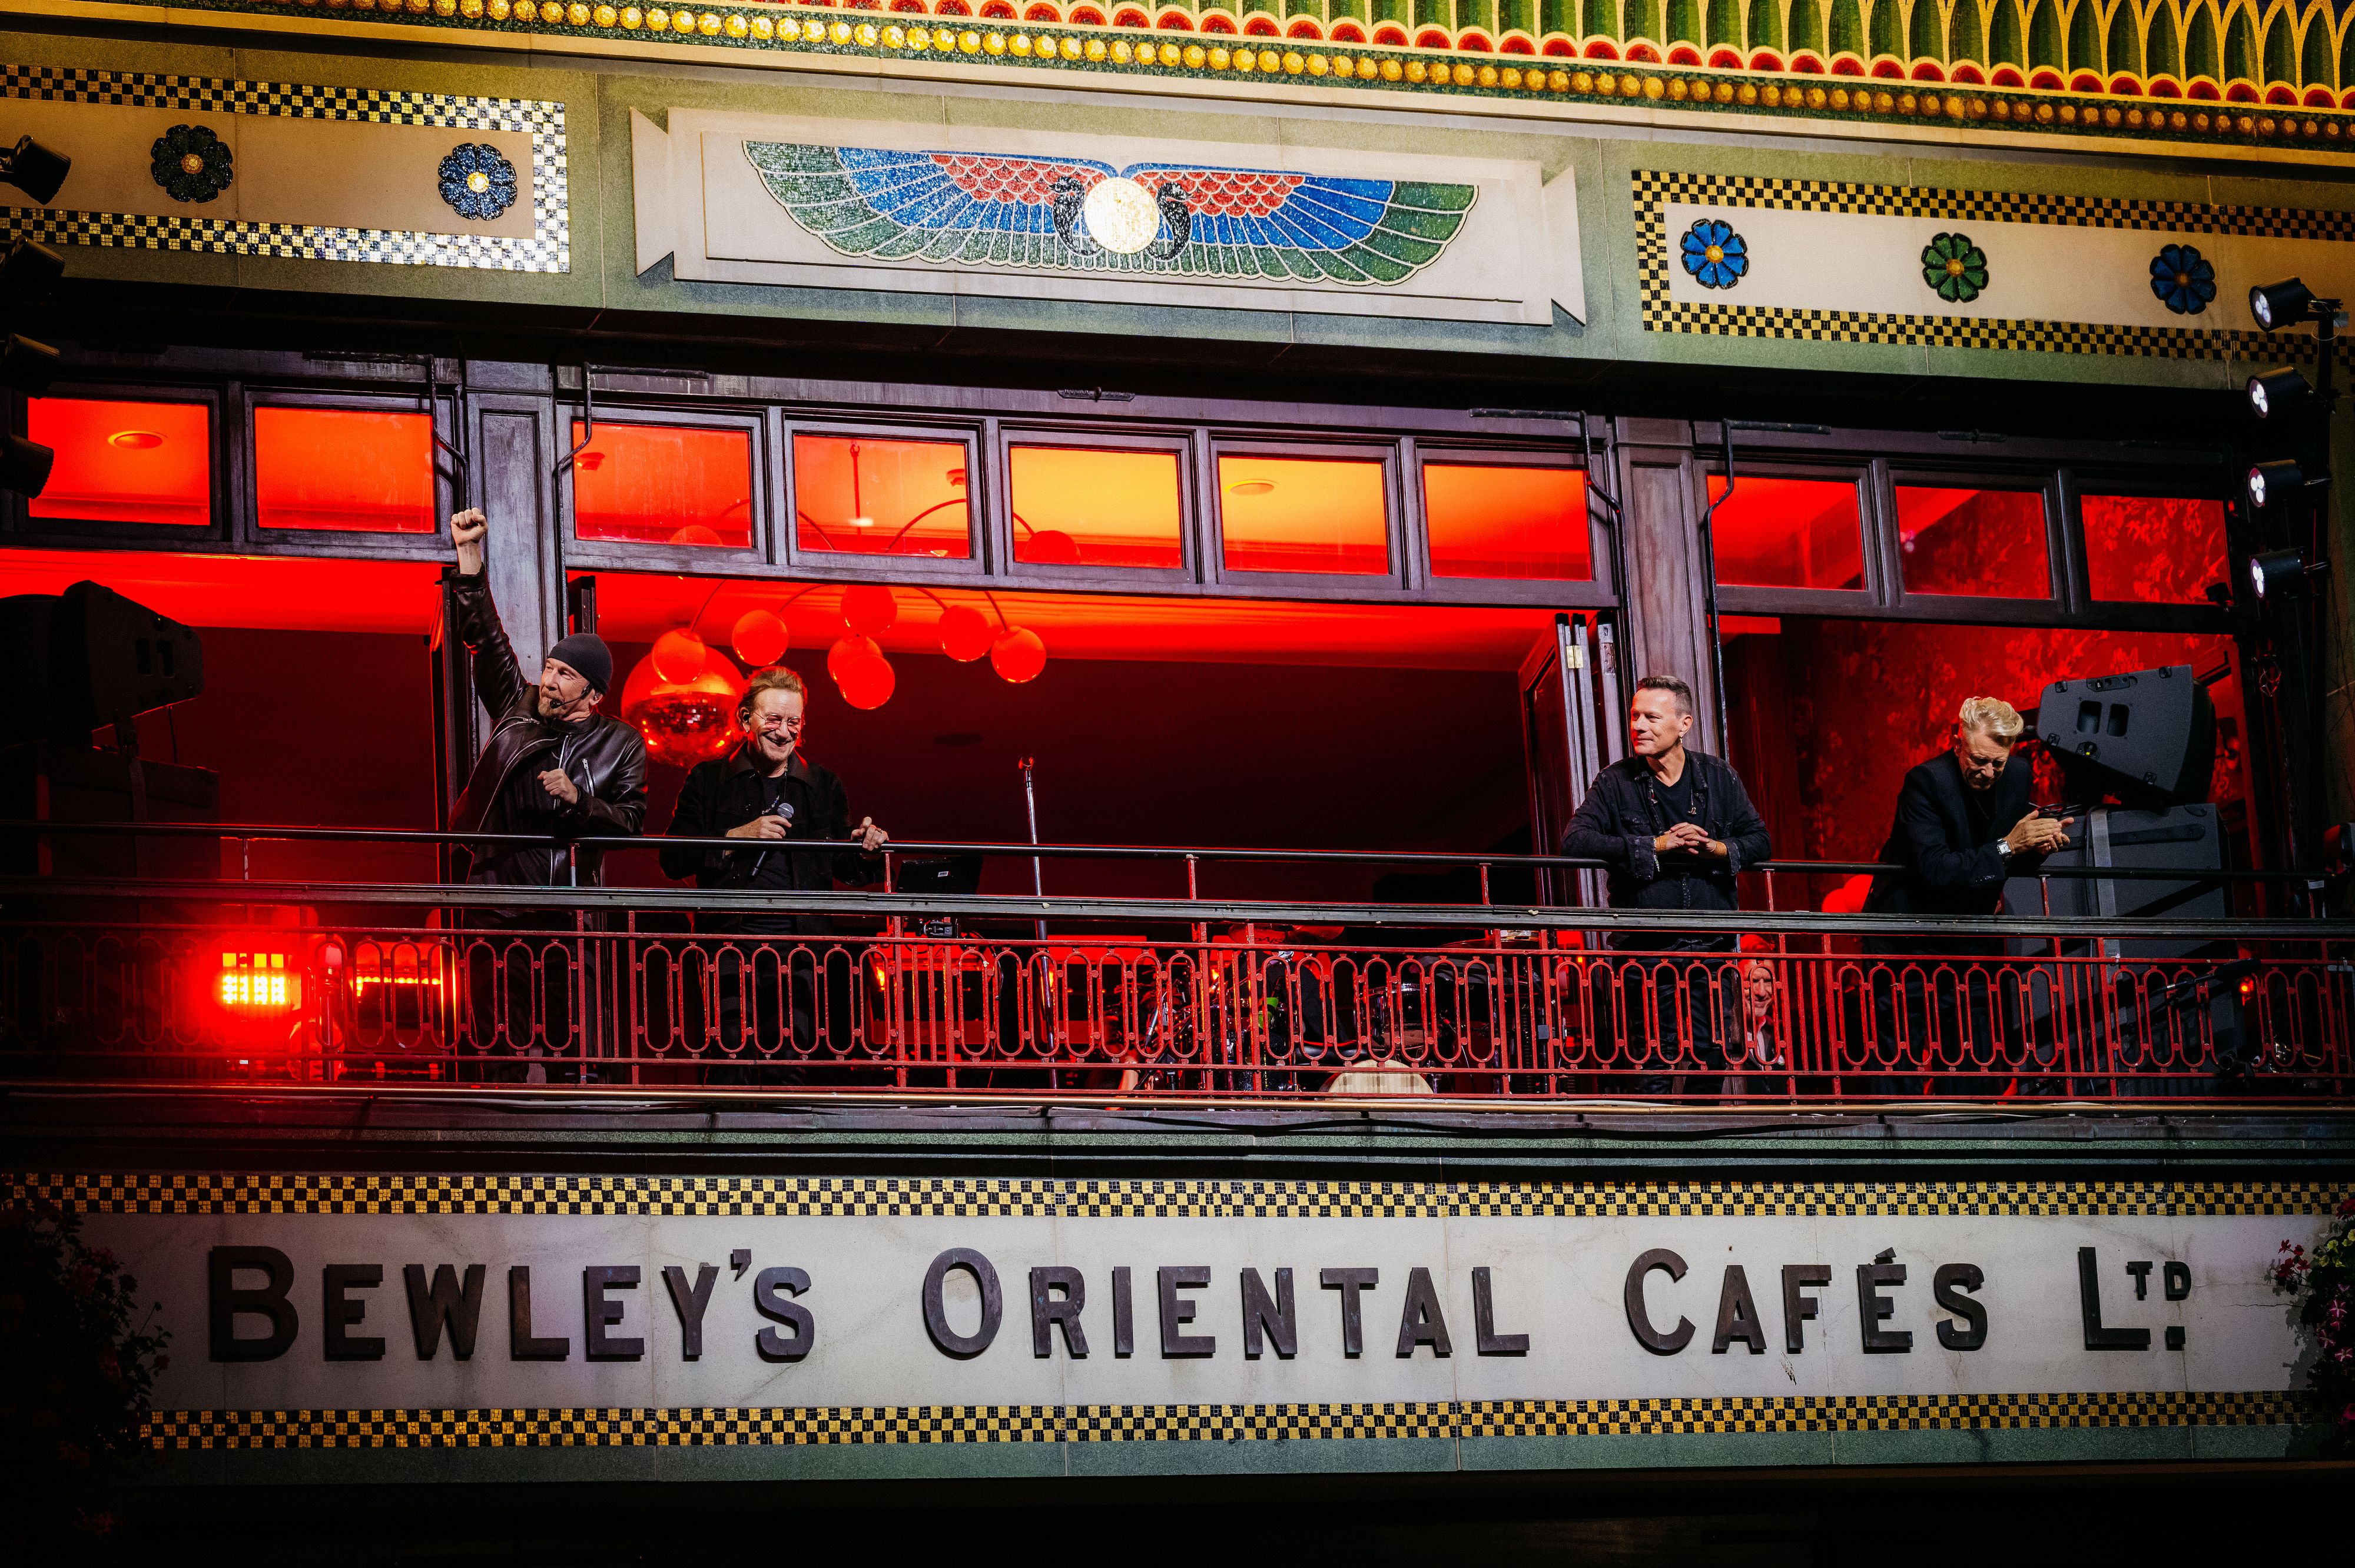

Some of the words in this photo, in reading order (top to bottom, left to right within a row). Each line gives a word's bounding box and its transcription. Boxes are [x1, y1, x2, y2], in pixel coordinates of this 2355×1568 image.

[207, 1245, 815, 1363] BEWLEY'S
[922, 1247, 1531, 1360] ORIENTAL
[1624, 1246, 1988, 1356] CAFÉS
